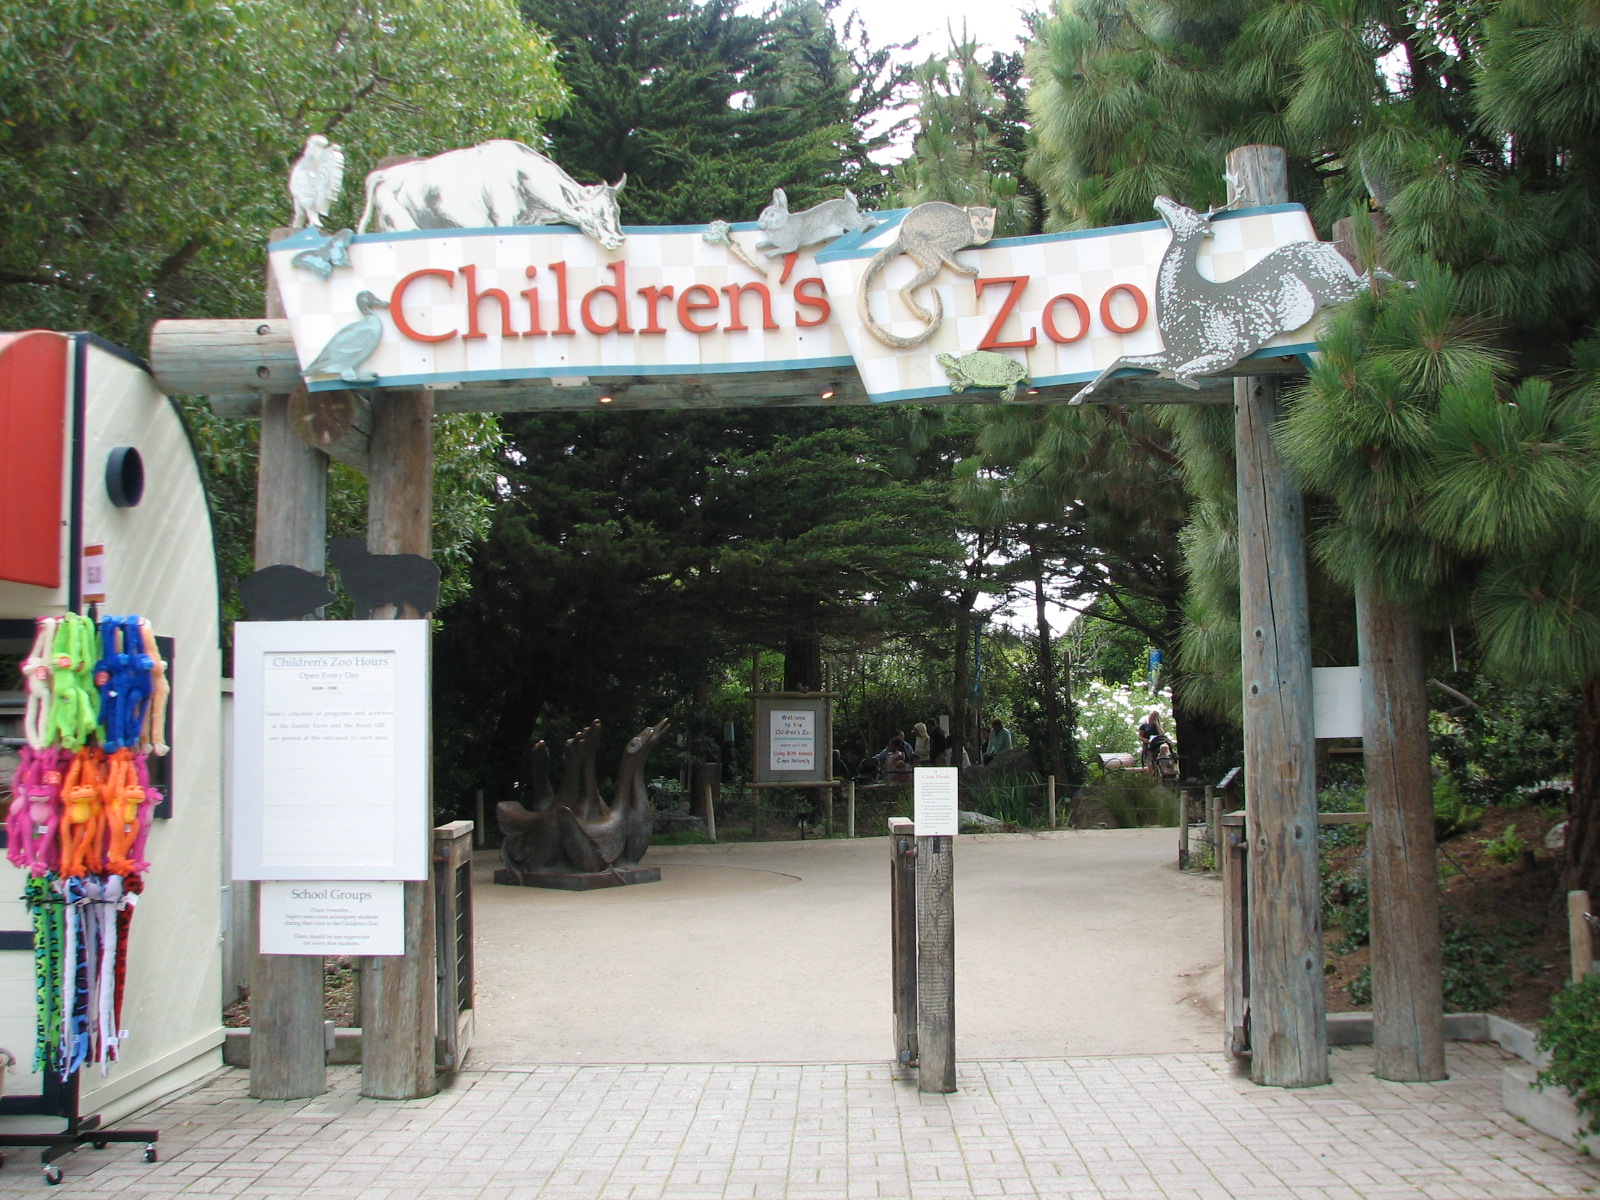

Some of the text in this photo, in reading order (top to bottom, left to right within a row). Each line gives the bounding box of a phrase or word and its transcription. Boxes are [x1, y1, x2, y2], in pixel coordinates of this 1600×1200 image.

[389, 255, 1148, 350] Children's Zoo
[273, 657, 389, 667] Children's Zoo Hours
[299, 672, 360, 680] Open Every Day
[291, 889, 372, 902] School Groups
